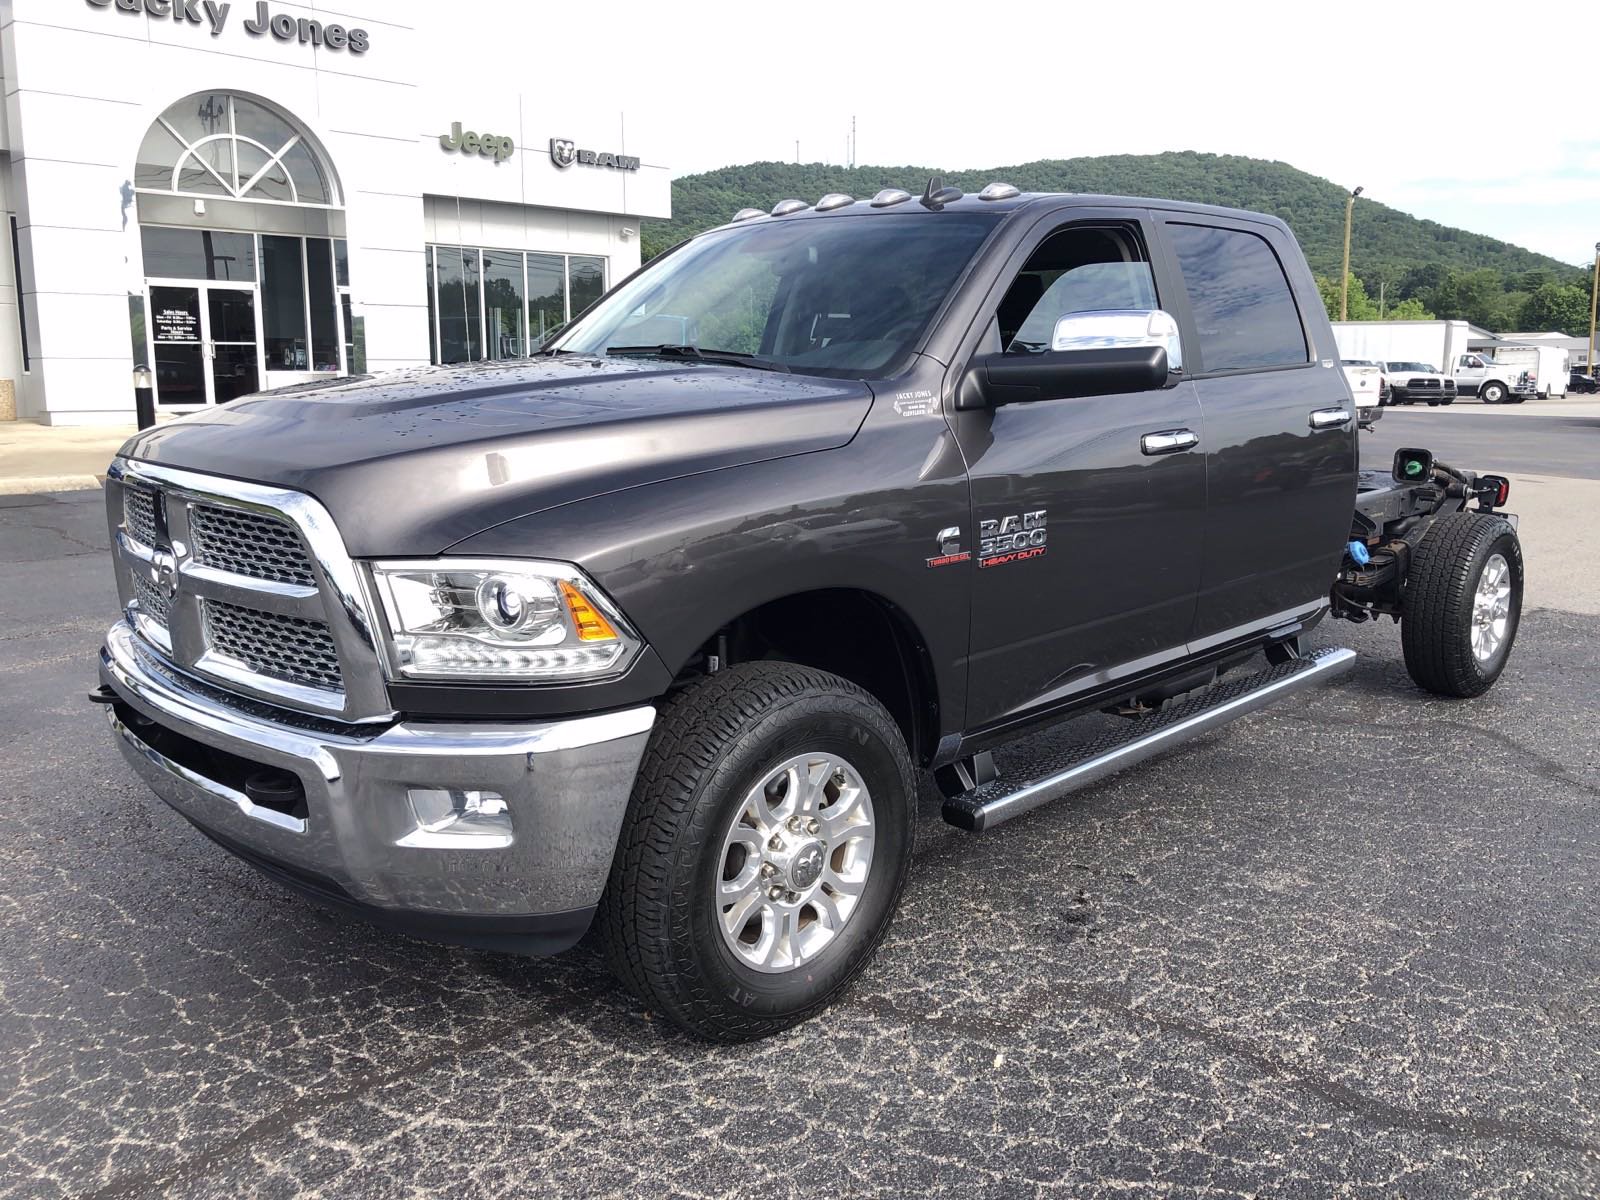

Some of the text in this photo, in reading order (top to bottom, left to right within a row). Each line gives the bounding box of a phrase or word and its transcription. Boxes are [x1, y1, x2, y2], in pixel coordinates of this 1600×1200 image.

[86, 0, 370, 52] cky Jones
[440, 121, 515, 162] Jeep
[577, 149, 640, 170] RAM
[980, 509, 1047, 538] RAM
[980, 528, 1047, 556] 3500
[983, 548, 1045, 567] HEAVY DUTY
